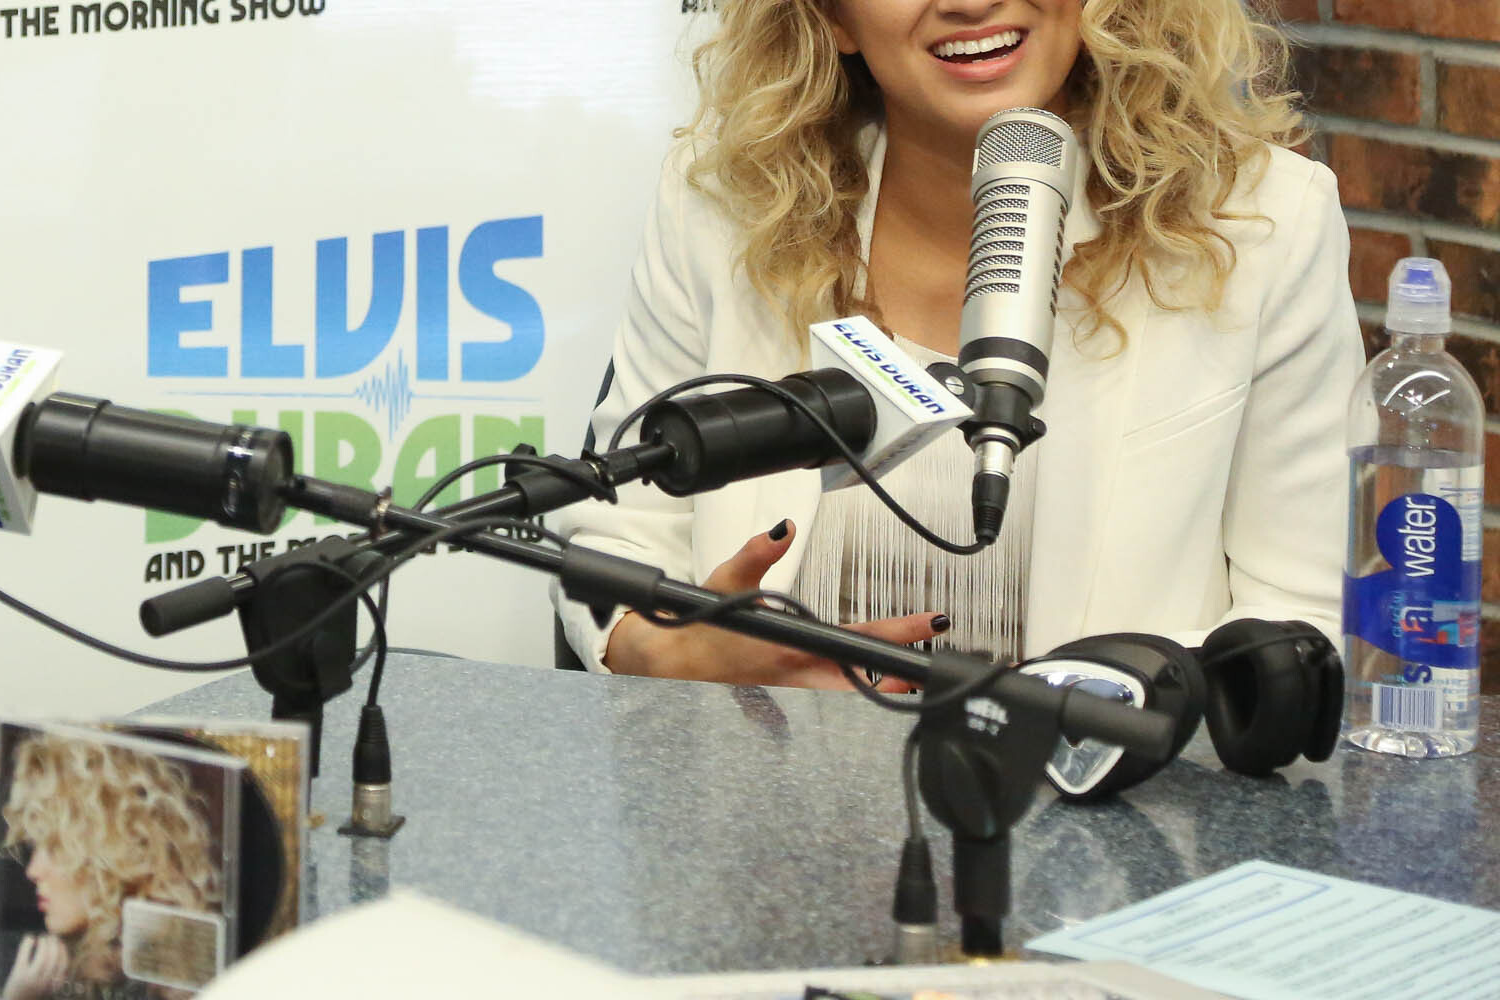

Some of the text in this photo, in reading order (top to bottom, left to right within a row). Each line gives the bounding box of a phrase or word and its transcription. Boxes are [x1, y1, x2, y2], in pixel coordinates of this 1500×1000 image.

[0, 6, 59, 38] THE
[147, 215, 545, 383] ELVIS
[1397, 496, 1437, 577] water
[145, 550, 205, 582] AND
